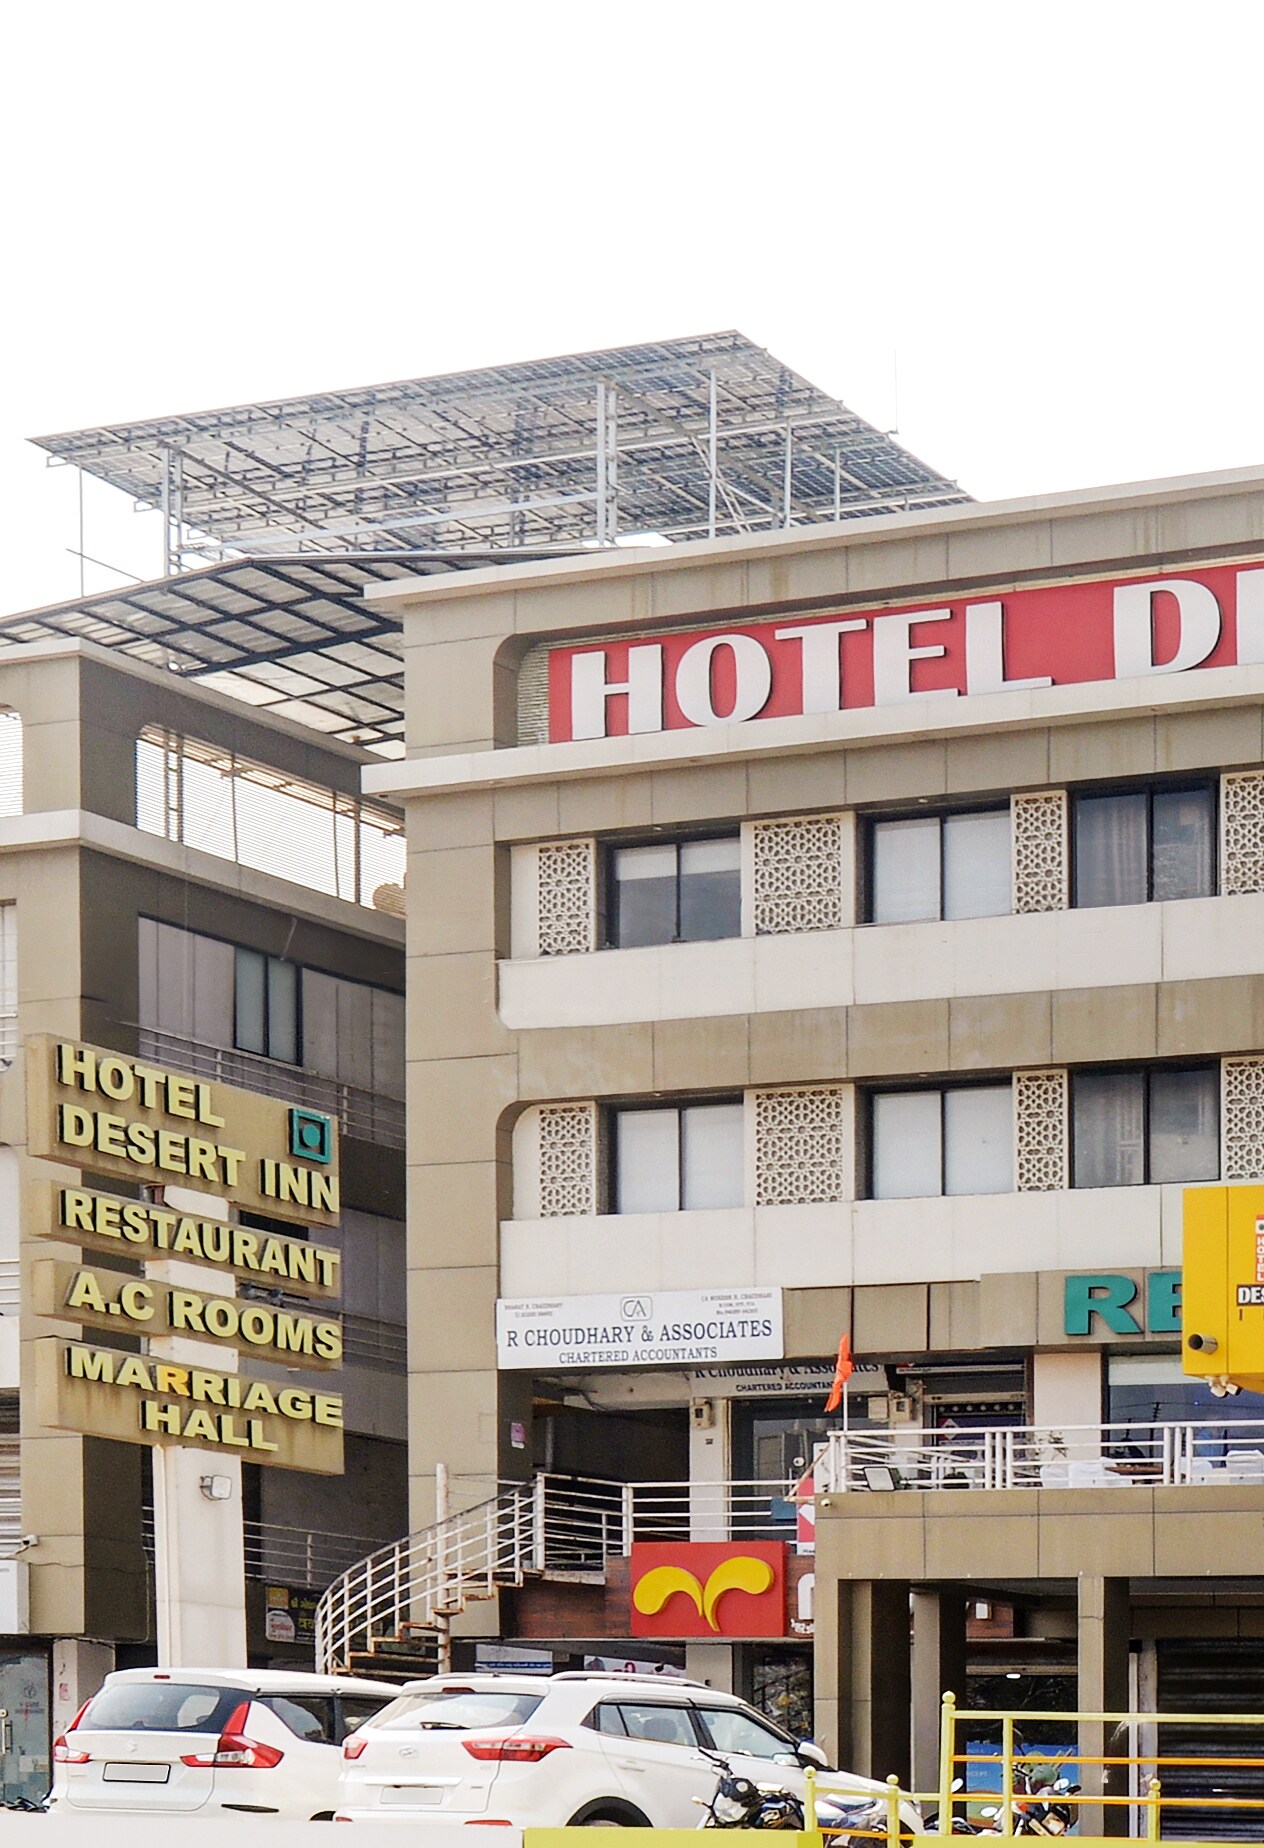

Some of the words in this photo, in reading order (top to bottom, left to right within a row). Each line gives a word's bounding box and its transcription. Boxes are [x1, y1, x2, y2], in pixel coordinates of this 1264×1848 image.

[571, 600, 1053, 741] HOTEL
[57, 1043, 226, 1129] HOTEL
[59, 1103, 246, 1187] DESERT
[260, 1158, 340, 1213] INN
[61, 1189, 340, 1287] RESTAURANT
[67, 1271, 155, 1321] A.C
[169, 1291, 343, 1360] ROOMS
[507, 1330, 519, 1347] R
[524, 1325, 635, 1347] CHOUDHARY
[641, 1325, 654, 1342] &
[659, 1319, 772, 1341] ASSOCIATES
[558, 1350, 629, 1364] CHARTERED
[632, 1346, 718, 1362] ACCOUNTANTS
[66, 1346, 344, 1428] MARRIAGE
[141, 1400, 279, 1452] HALL
[736, 1382, 784, 1392] CHARTERED
[785, 1381, 834, 1390] ACCOUNTAN
